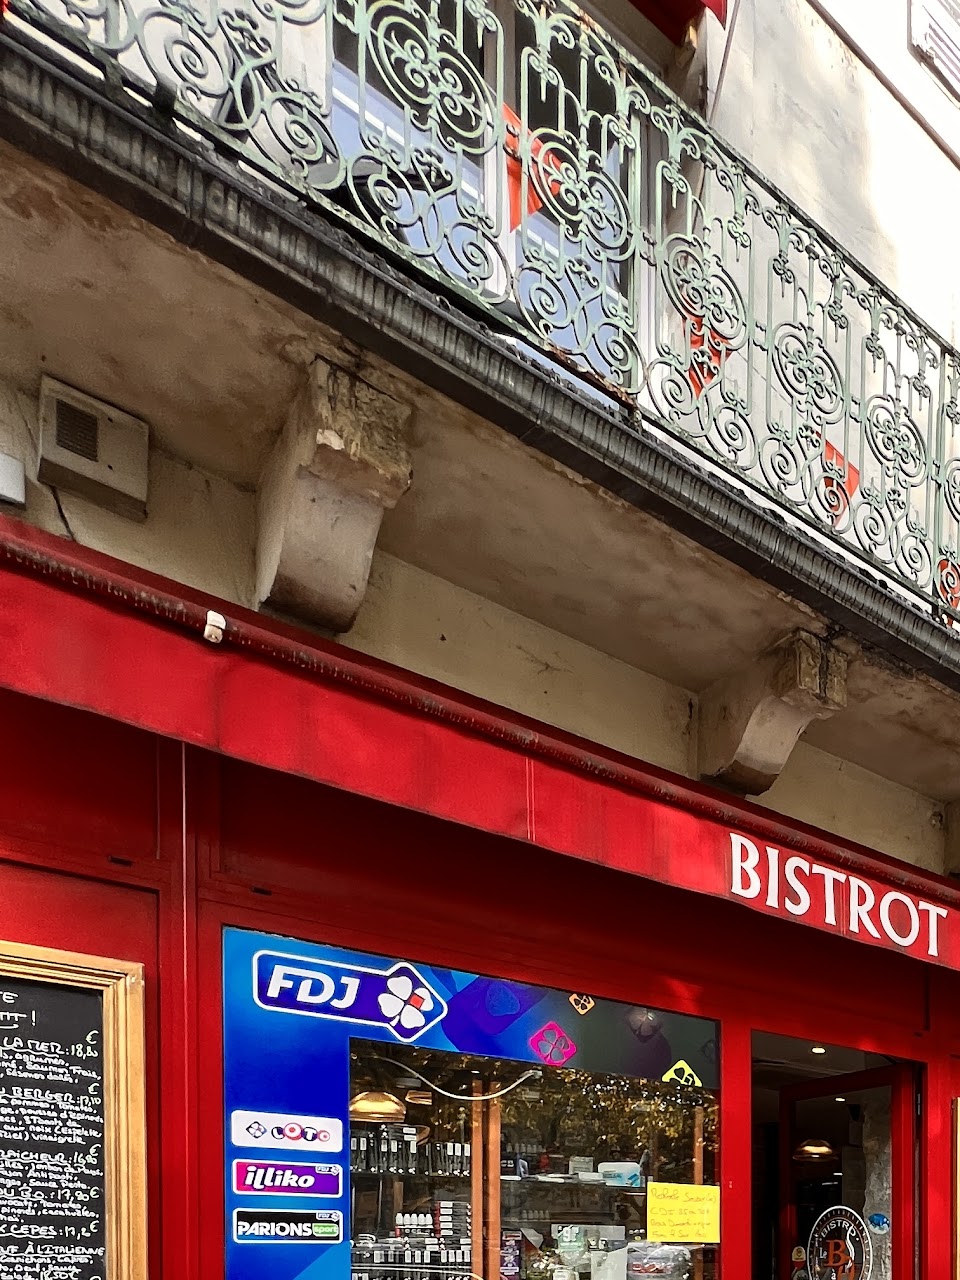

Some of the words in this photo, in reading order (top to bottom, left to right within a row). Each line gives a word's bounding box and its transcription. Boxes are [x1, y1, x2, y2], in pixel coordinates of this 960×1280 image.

[731, 832, 948, 957] BISTROT
[267, 965, 360, 1009] FDJ
[271, 1122, 331, 1142] LOTO
[245, 1166, 315, 1189] illiko
[237, 1221, 312, 1236] PARIONS
[313, 1224, 339, 1234] sport
